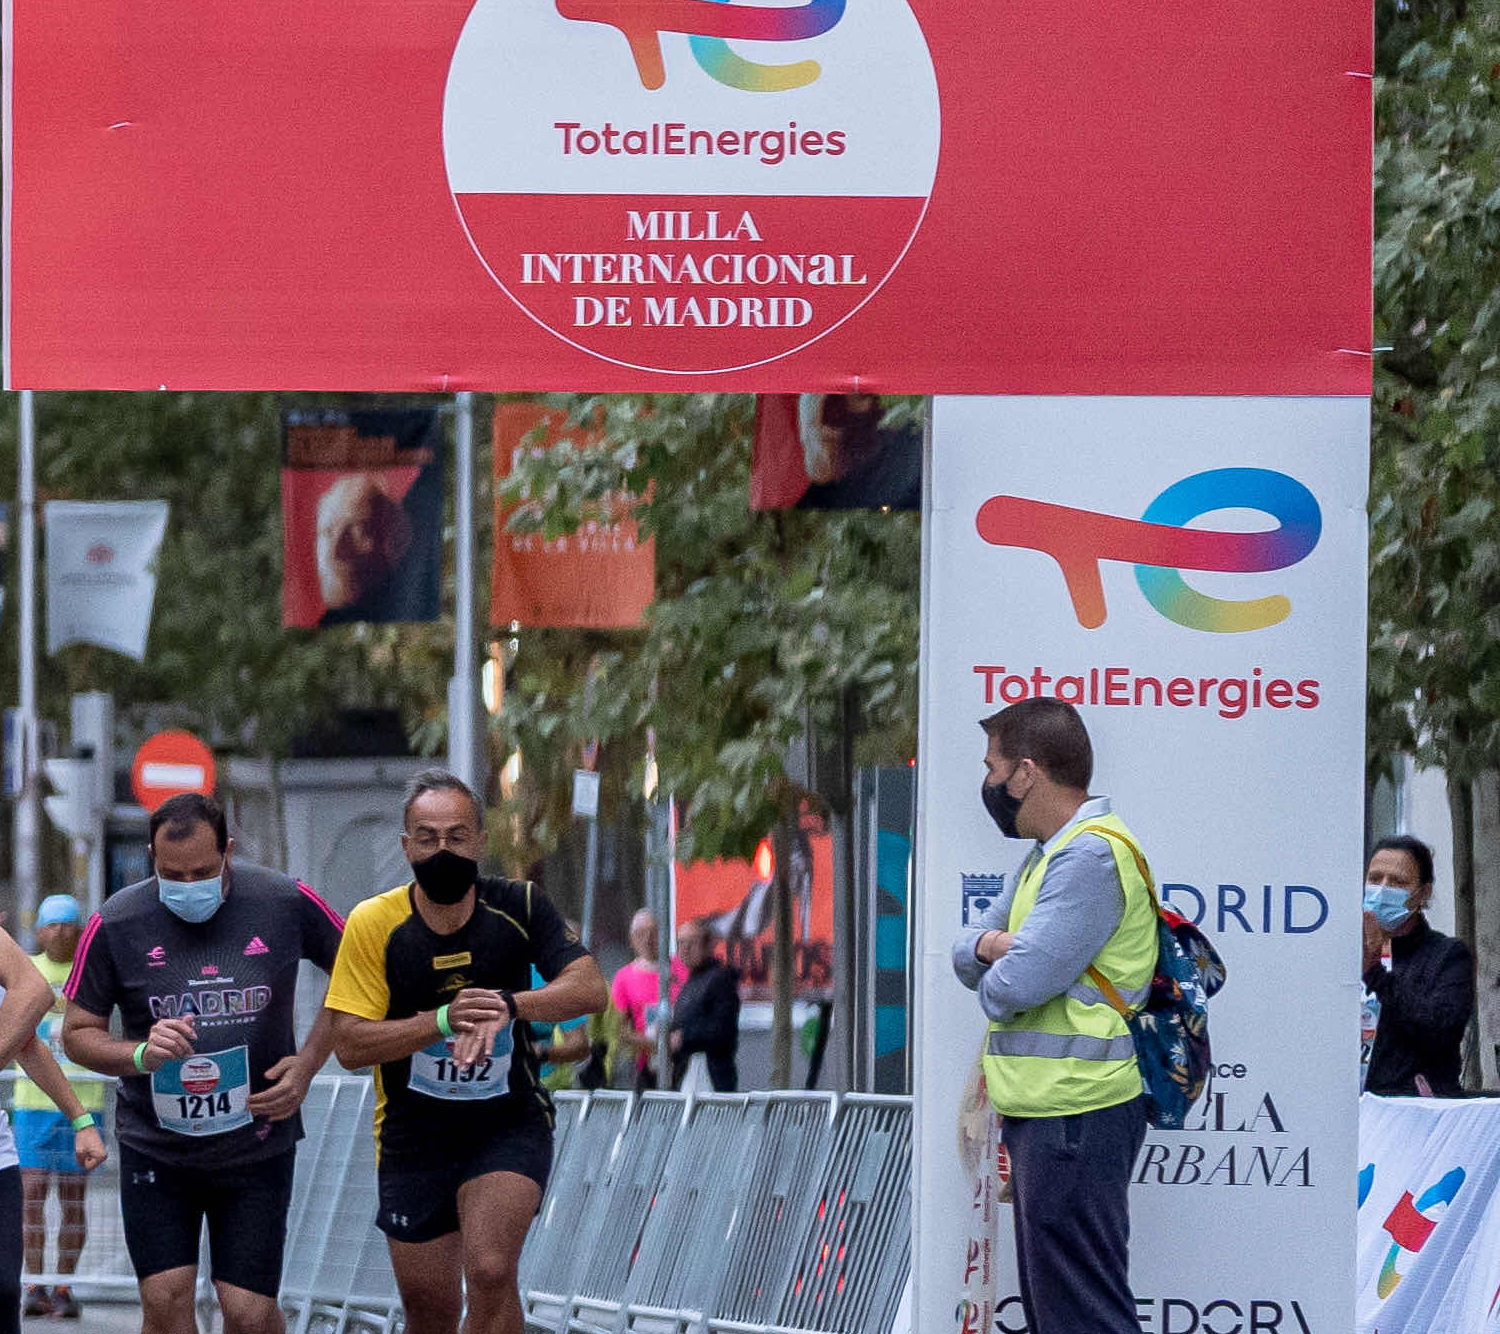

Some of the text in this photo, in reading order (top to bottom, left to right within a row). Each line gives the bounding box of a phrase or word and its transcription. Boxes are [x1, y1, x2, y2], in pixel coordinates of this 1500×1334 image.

[554, 121, 847, 165] TotalEnergies
[625, 210, 763, 242] MILLA
[572, 296, 815, 329] DE MADRID
[973, 665, 1320, 719] TotalEnergies
[1161, 883, 1329, 935] DRID
[148, 985, 272, 1019] MADRID
[177, 1092, 231, 1118] 1214
[1130, 1144, 1316, 1188] RBANA
